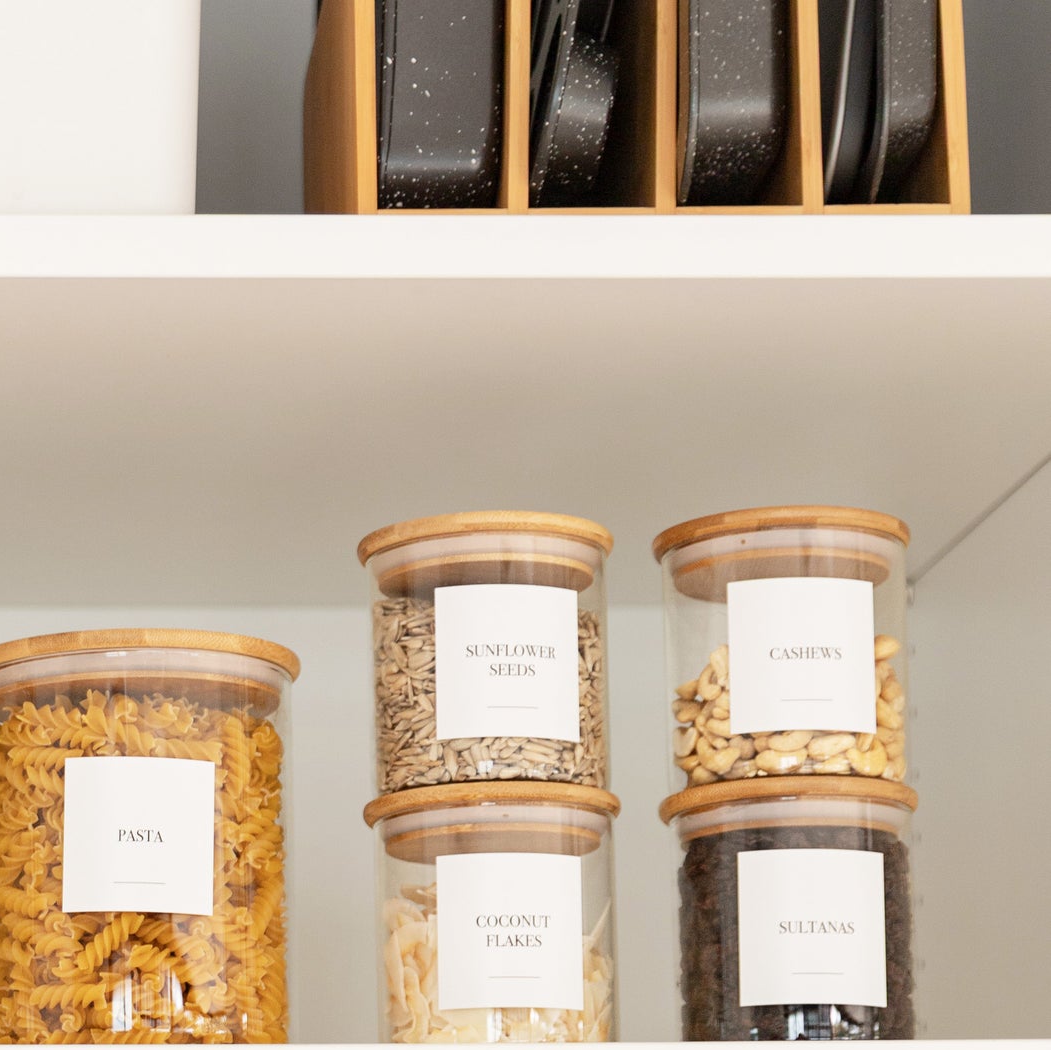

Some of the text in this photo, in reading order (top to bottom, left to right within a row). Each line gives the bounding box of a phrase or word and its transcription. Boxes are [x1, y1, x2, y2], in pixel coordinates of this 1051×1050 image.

[465, 643, 556, 659] SUNFLOWER
[769, 646, 843, 660] CASHEWS
[489, 663, 536, 677] SEEDS
[118, 828, 164, 843] PASTA
[476, 914, 551, 929] COCONUT
[778, 920, 855, 934] SULTANAS
[486, 934, 543, 948] FLAKES
